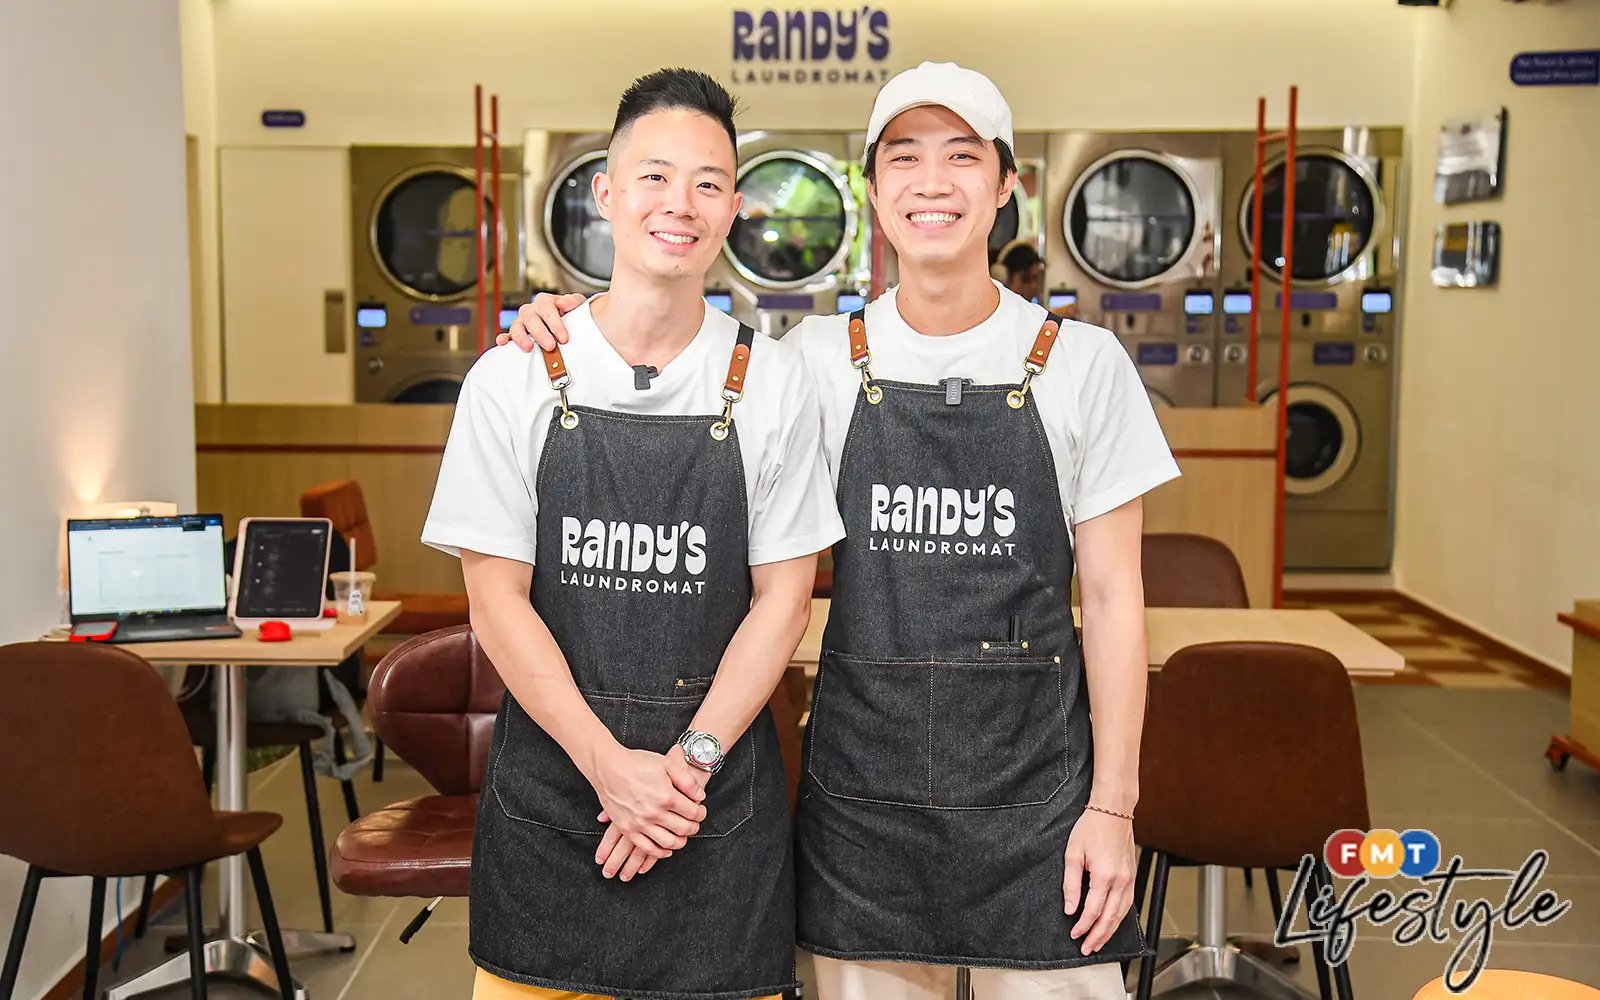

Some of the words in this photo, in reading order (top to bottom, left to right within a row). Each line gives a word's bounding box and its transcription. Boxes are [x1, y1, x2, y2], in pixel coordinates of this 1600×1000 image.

[731, 69, 888, 83] LAUNDROMAT
[869, 537, 1016, 556] LAUNDROMAT
[560, 570, 706, 594] LAUNDROMAT
